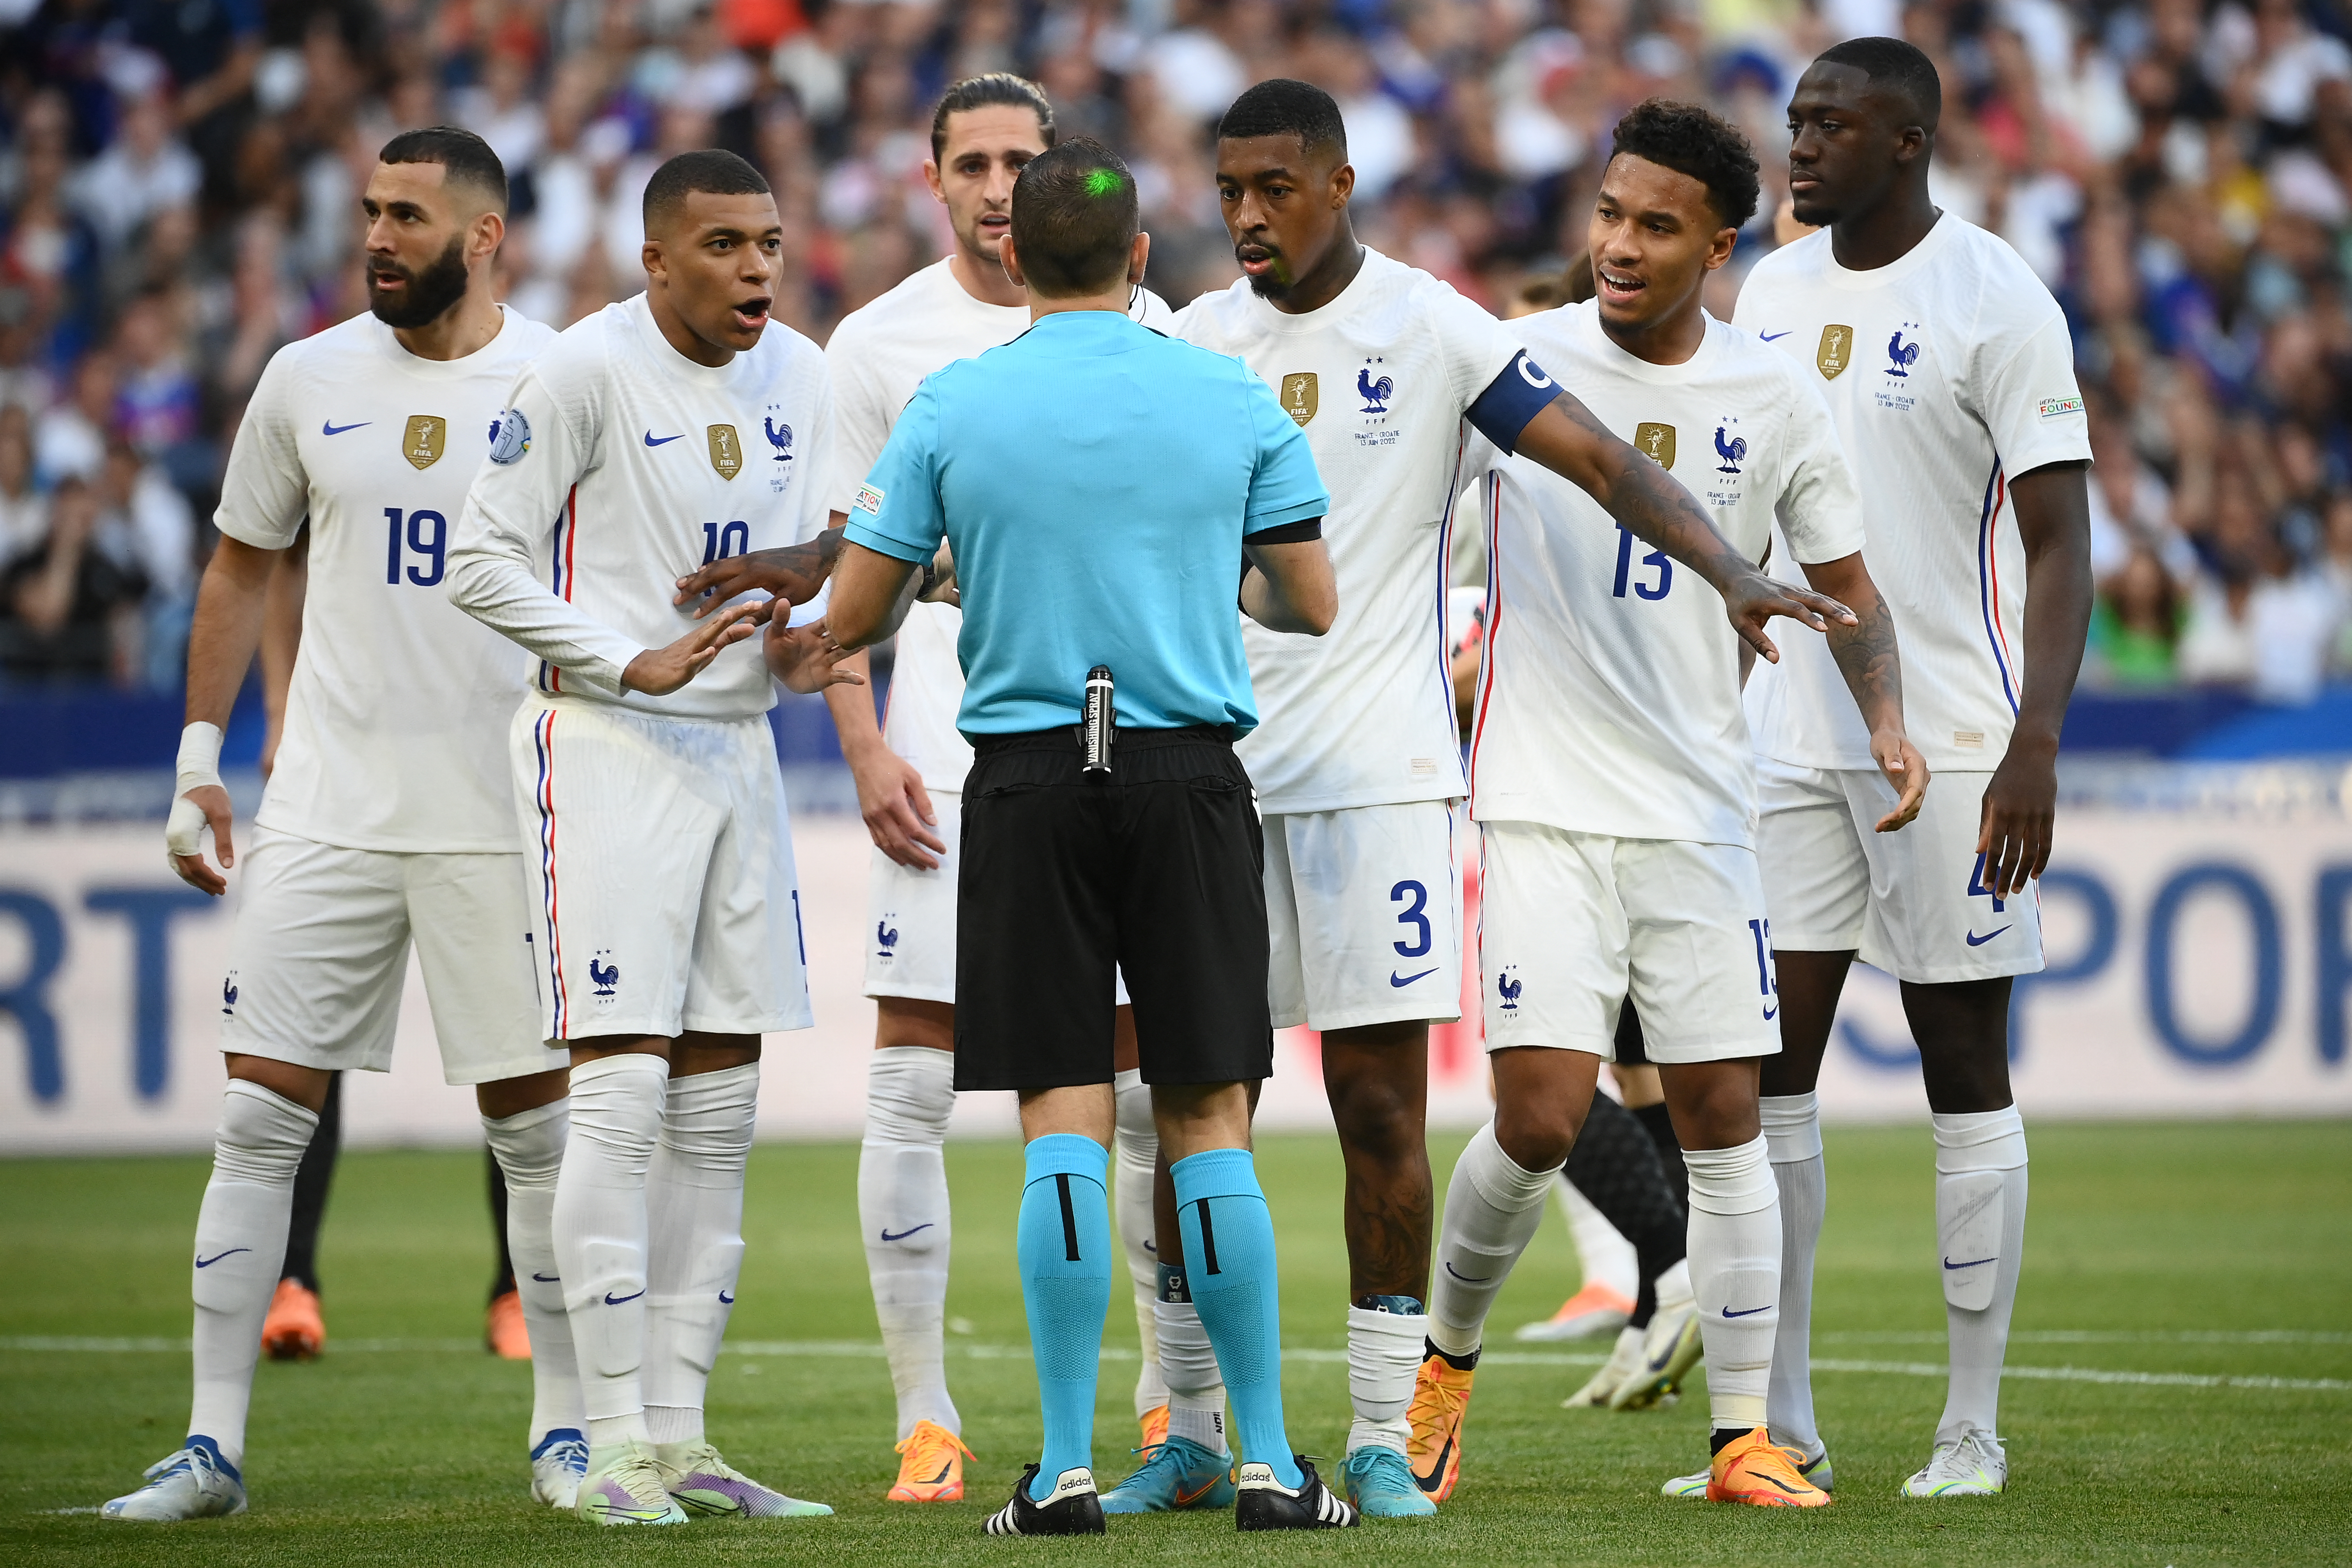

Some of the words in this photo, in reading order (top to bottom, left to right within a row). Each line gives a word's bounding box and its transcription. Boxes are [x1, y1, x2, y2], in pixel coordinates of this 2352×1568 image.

[1518, 356, 1552, 388] C
[384, 508, 446, 587] 19
[1613, 522, 1672, 601] 13
[1089, 693, 1098, 719] SPRAY
[1087, 719, 1098, 764] VANISHING
[1968, 850, 2005, 913] 4
[1391, 880, 1431, 957] 3
[1060, 1477, 1091, 1491] adidas
[1241, 1472, 1270, 1482] adidas
